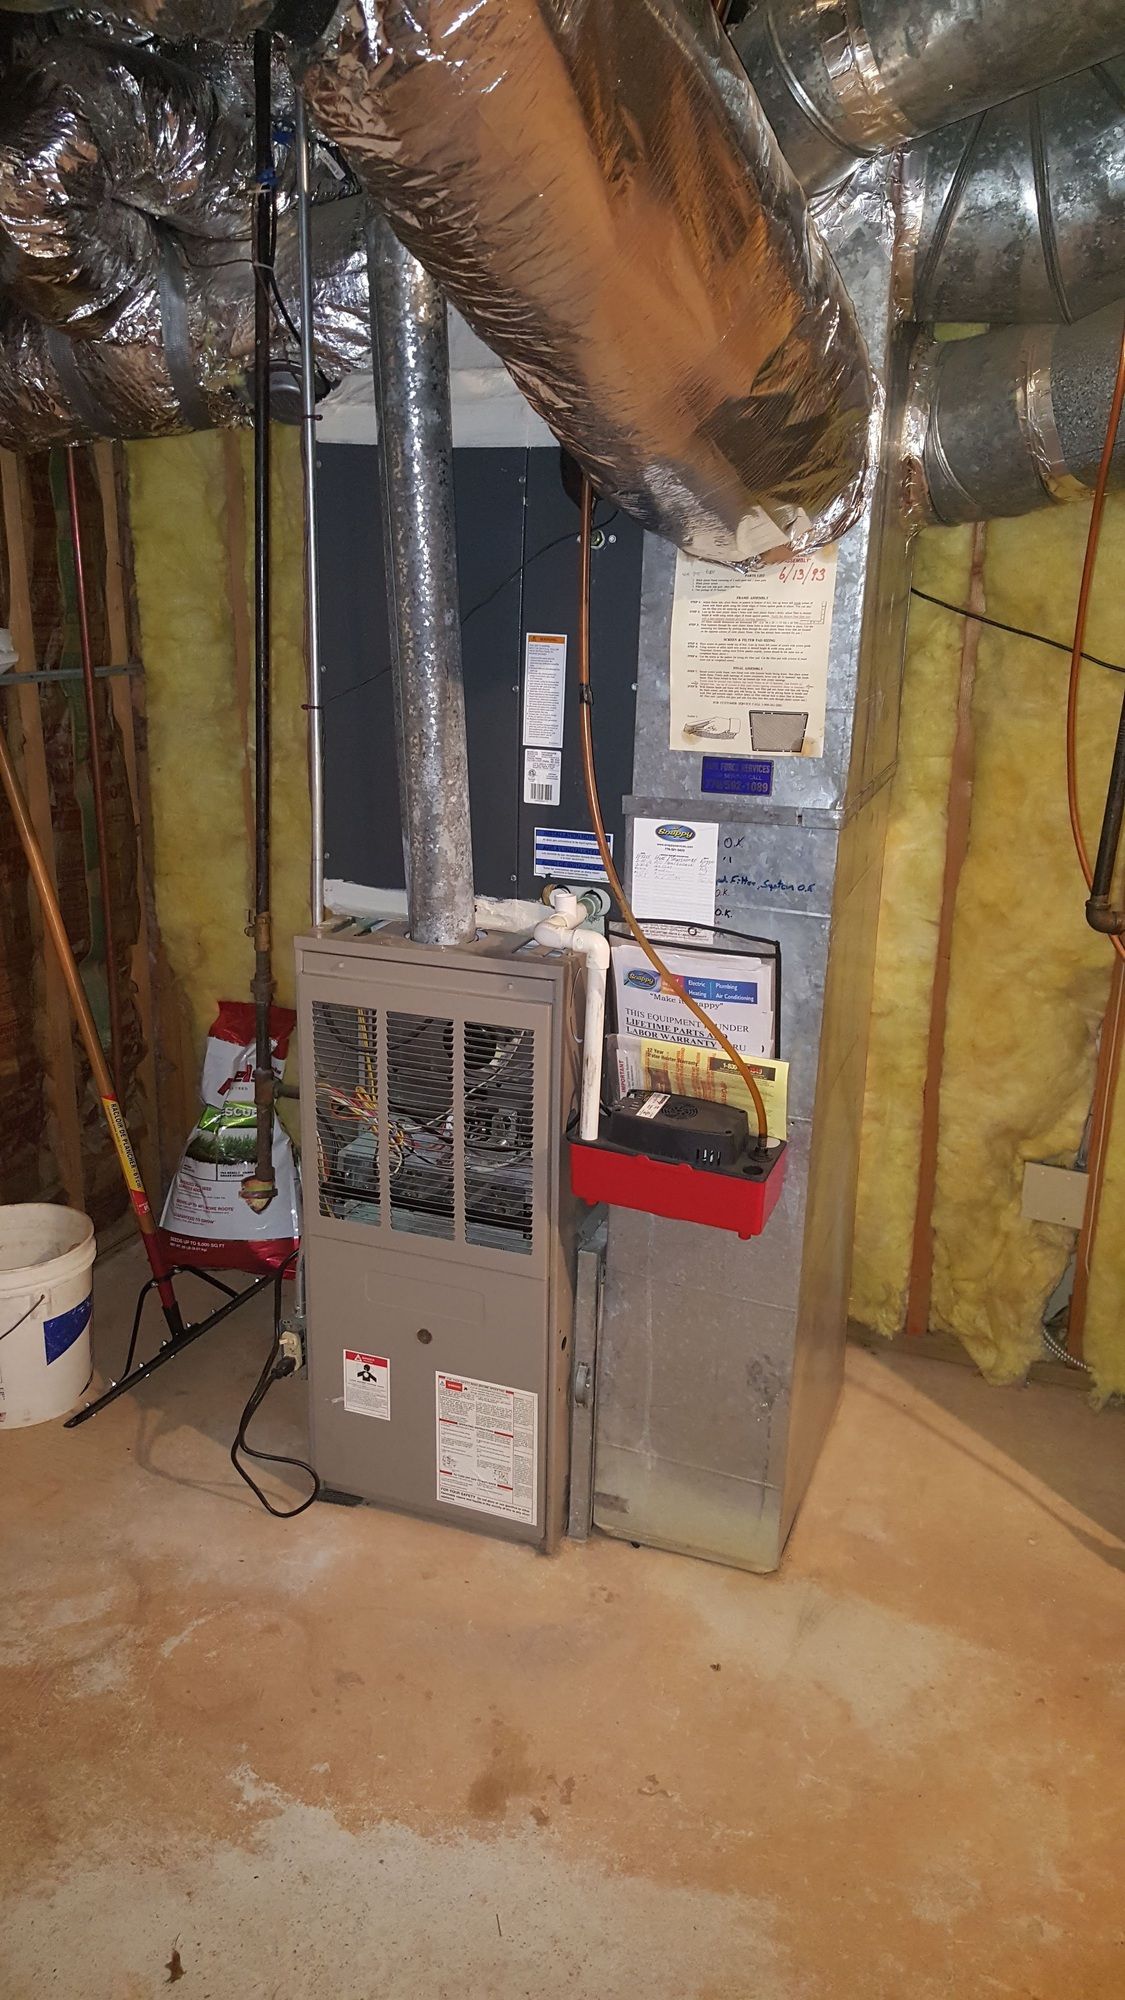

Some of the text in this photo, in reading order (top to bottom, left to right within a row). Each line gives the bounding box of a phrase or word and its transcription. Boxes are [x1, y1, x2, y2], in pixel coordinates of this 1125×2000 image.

[779, 562, 826, 585] 6/13/93
[658, 828, 693, 839] Snappy
[688, 979, 706, 987] Electric
[715, 982, 738, 991] Plumbing
[688, 989, 707, 998] Heating
[724, 995, 755, 1003] Conditioning
[625, 1008, 645, 1018] THIS
[647, 1013, 701, 1028] EQUIPMENT
[626, 1017, 671, 1032] LIFETIME
[673, 1028, 705, 1038] PARTS
[626, 1026, 659, 1039] LABOR
[660, 1032, 717, 1048] WARRANTY
[618, 1060, 627, 1093] IMPORTANT
[111, 1103, 122, 1127] RACLOIR
[119, 1129, 127, 1137] DE
[123, 1138, 137, 1170] PLANCHER
